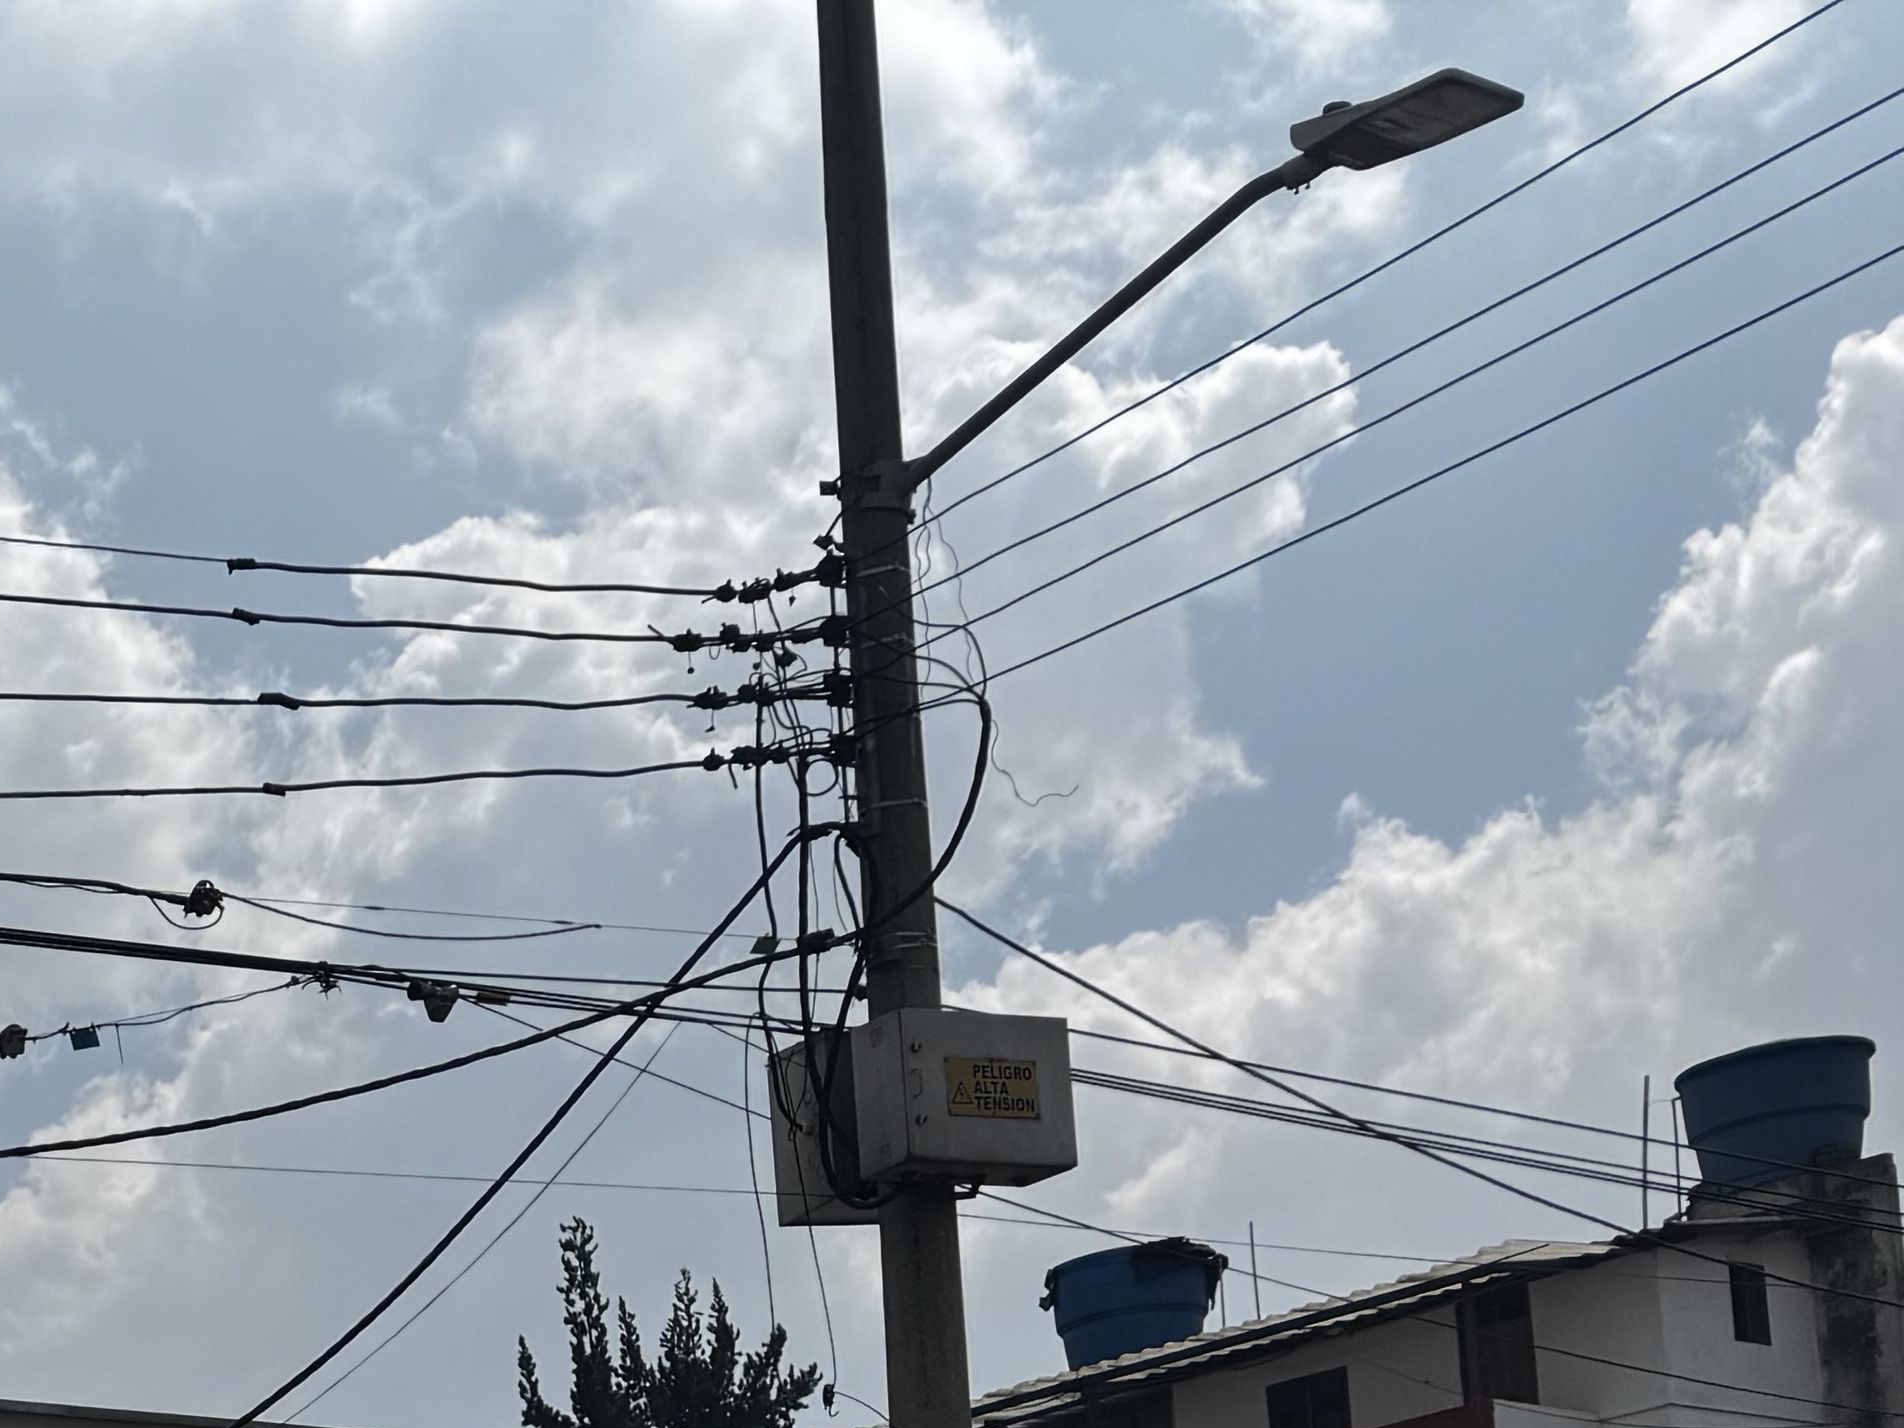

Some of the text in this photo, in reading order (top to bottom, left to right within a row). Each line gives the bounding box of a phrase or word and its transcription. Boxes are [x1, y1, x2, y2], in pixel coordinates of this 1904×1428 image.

[973, 1064, 1032, 1081] PELIGRO
[974, 1080, 1009, 1096] ALTA
[974, 1096, 1035, 1112] TENSION
